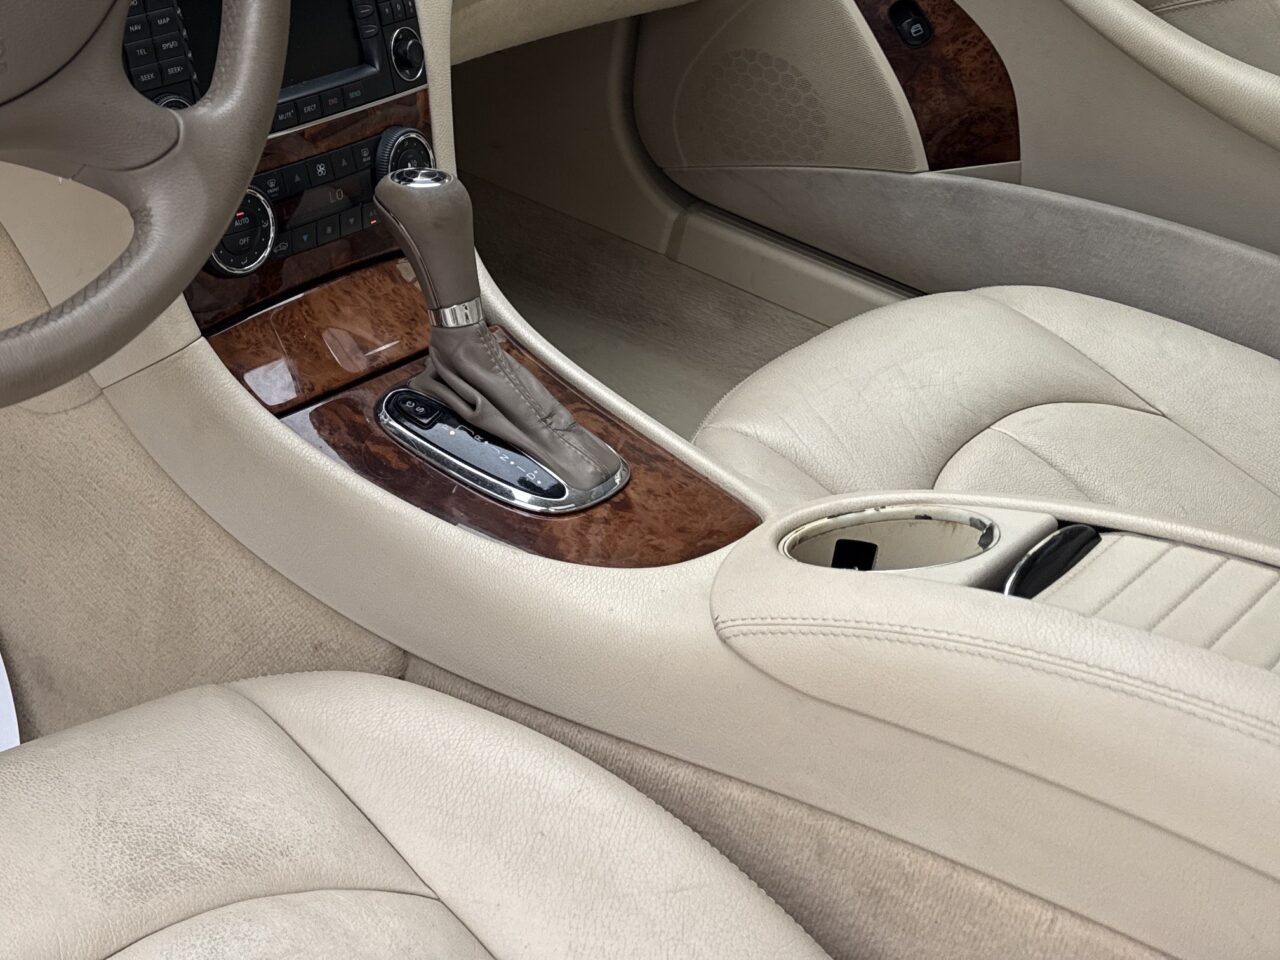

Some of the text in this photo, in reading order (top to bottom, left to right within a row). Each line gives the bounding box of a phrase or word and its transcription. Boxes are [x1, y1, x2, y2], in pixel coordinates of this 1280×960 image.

[157, 16, 170, 25] MAP
[129, 24, 142, 33] NAV
[136, 48, 147, 56] TEL
[303, 104, 317, 113] EJECT
[278, 112, 292, 121] MUTE
[234, 216, 250, 227] AUTO
[238, 236, 251, 245] OFF
